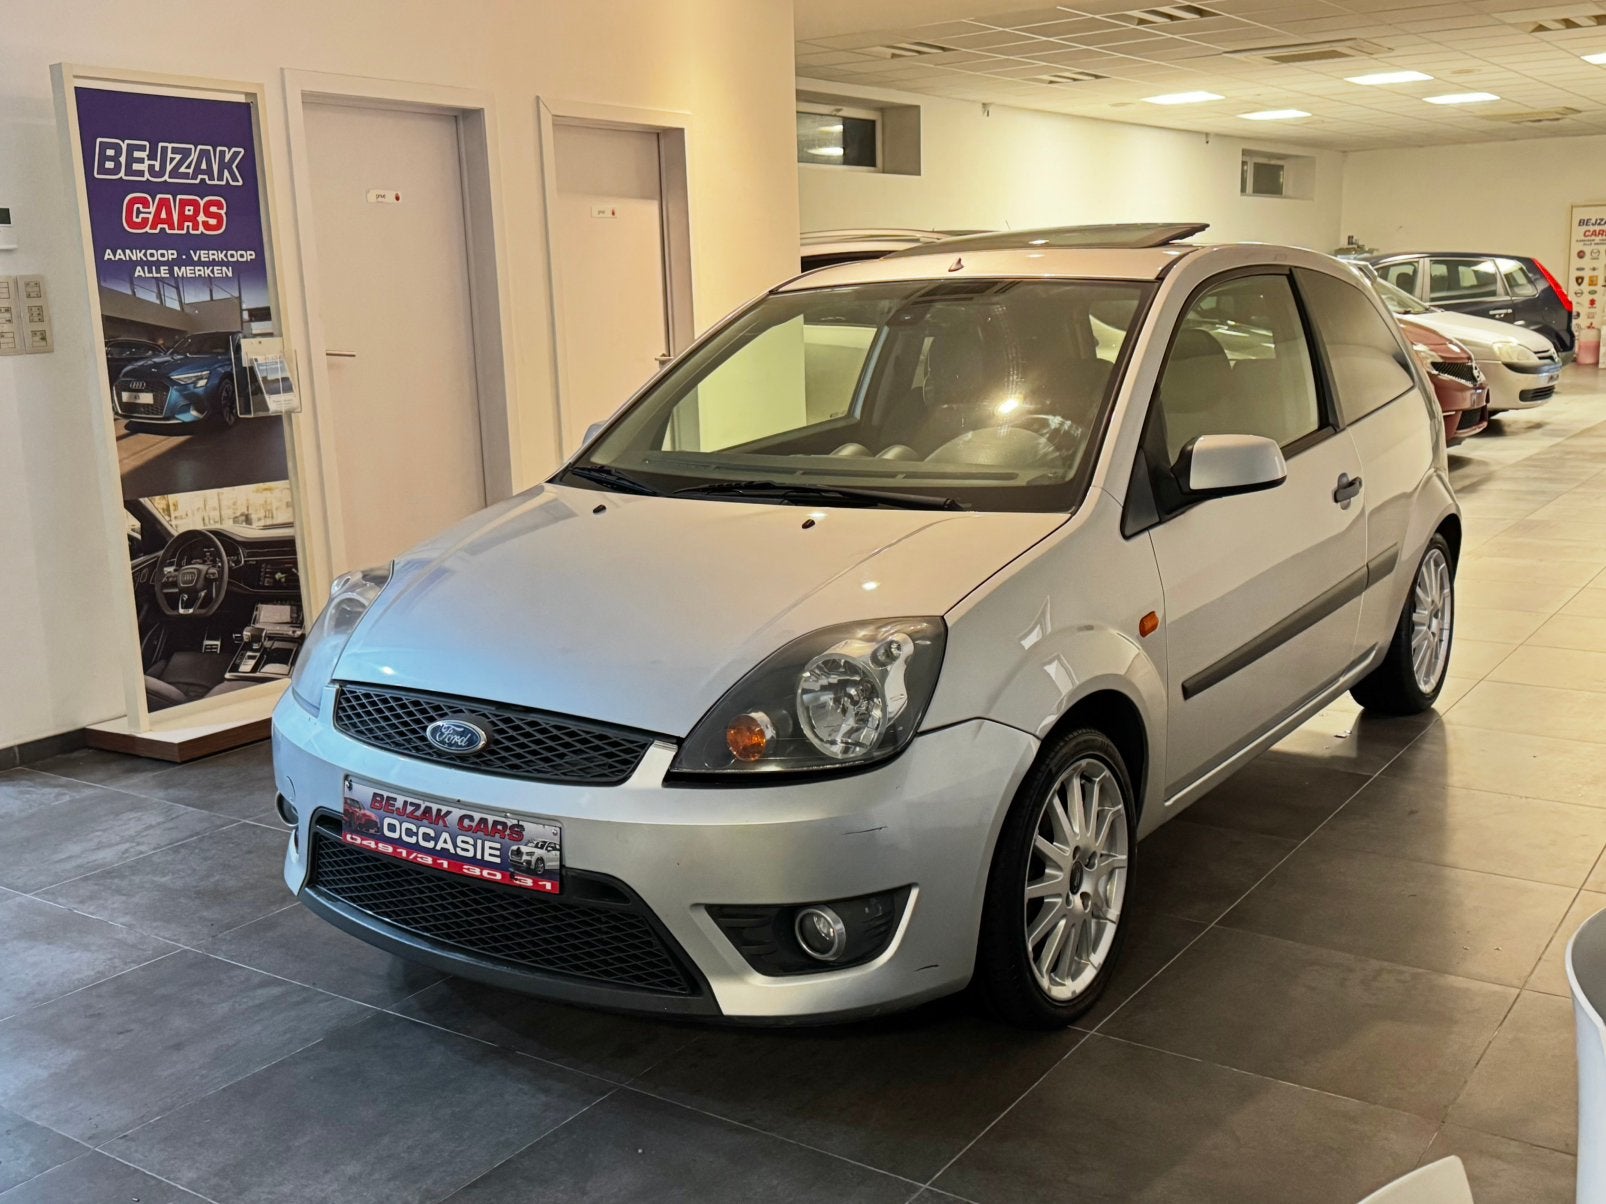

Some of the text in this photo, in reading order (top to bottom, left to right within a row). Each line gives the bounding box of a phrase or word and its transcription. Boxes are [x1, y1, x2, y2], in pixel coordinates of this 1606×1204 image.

[94, 138, 244, 185] BEJZAK
[124, 193, 226, 234] CARS
[1578, 218, 1606, 226] BEJZ
[1583, 229, 1606, 238] CAR
[104, 249, 256, 262] AANKOOP VERKOOP
[134, 266, 233, 278] ALLE MERKEN
[436, 722, 472, 747] Ford
[370, 792, 525, 841] BEJZAK CARS
[382, 817, 501, 864] OCCASIE
[346, 834, 552, 890] 0491/31 30 31
